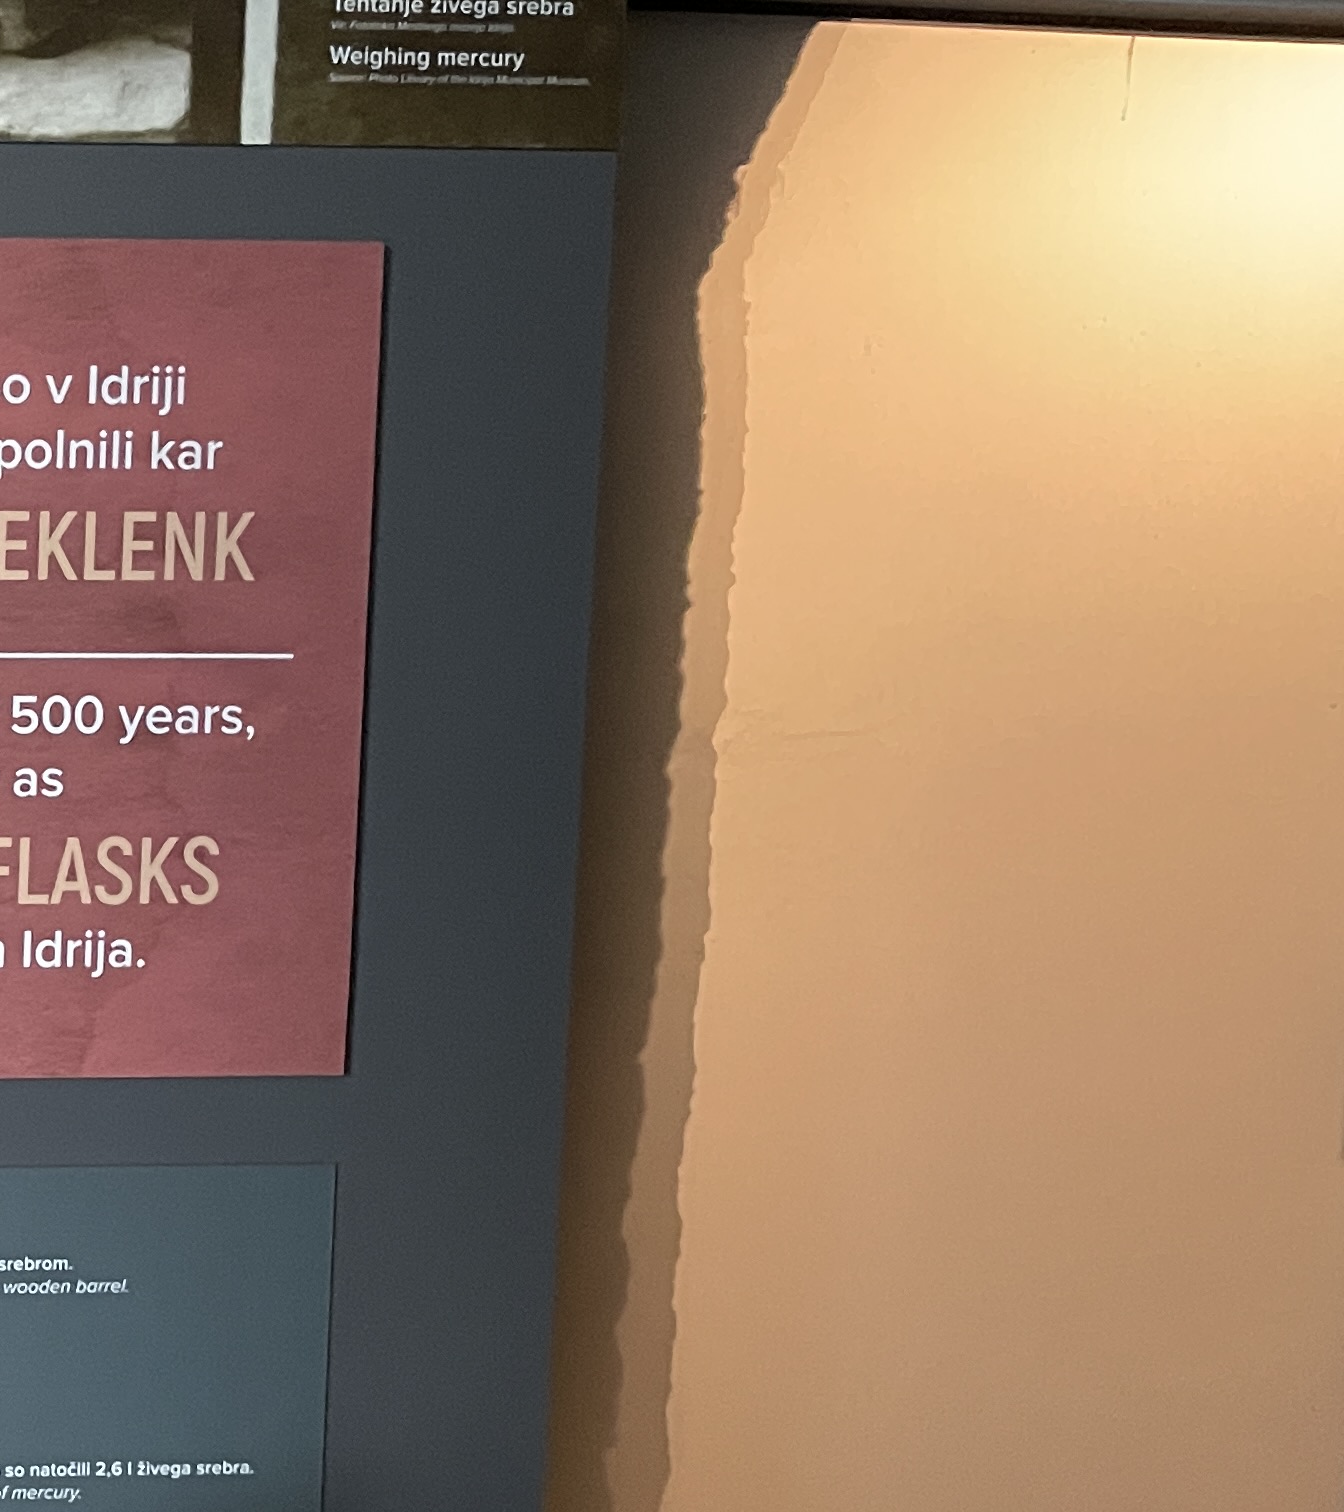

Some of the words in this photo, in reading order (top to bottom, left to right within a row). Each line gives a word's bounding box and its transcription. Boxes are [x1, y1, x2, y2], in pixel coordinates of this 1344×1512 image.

[330, 46, 430, 70] Weighing
[438, 52, 524, 71] mercury
[46, 375, 72, 403] v
[89, 365, 185, 415] Idriji
[151, 431, 223, 470] kar
[12, 695, 103, 734] 500
[119, 705, 254, 744] years,
[14, 768, 63, 797] as
[23, 930, 145, 977] Idrija.
